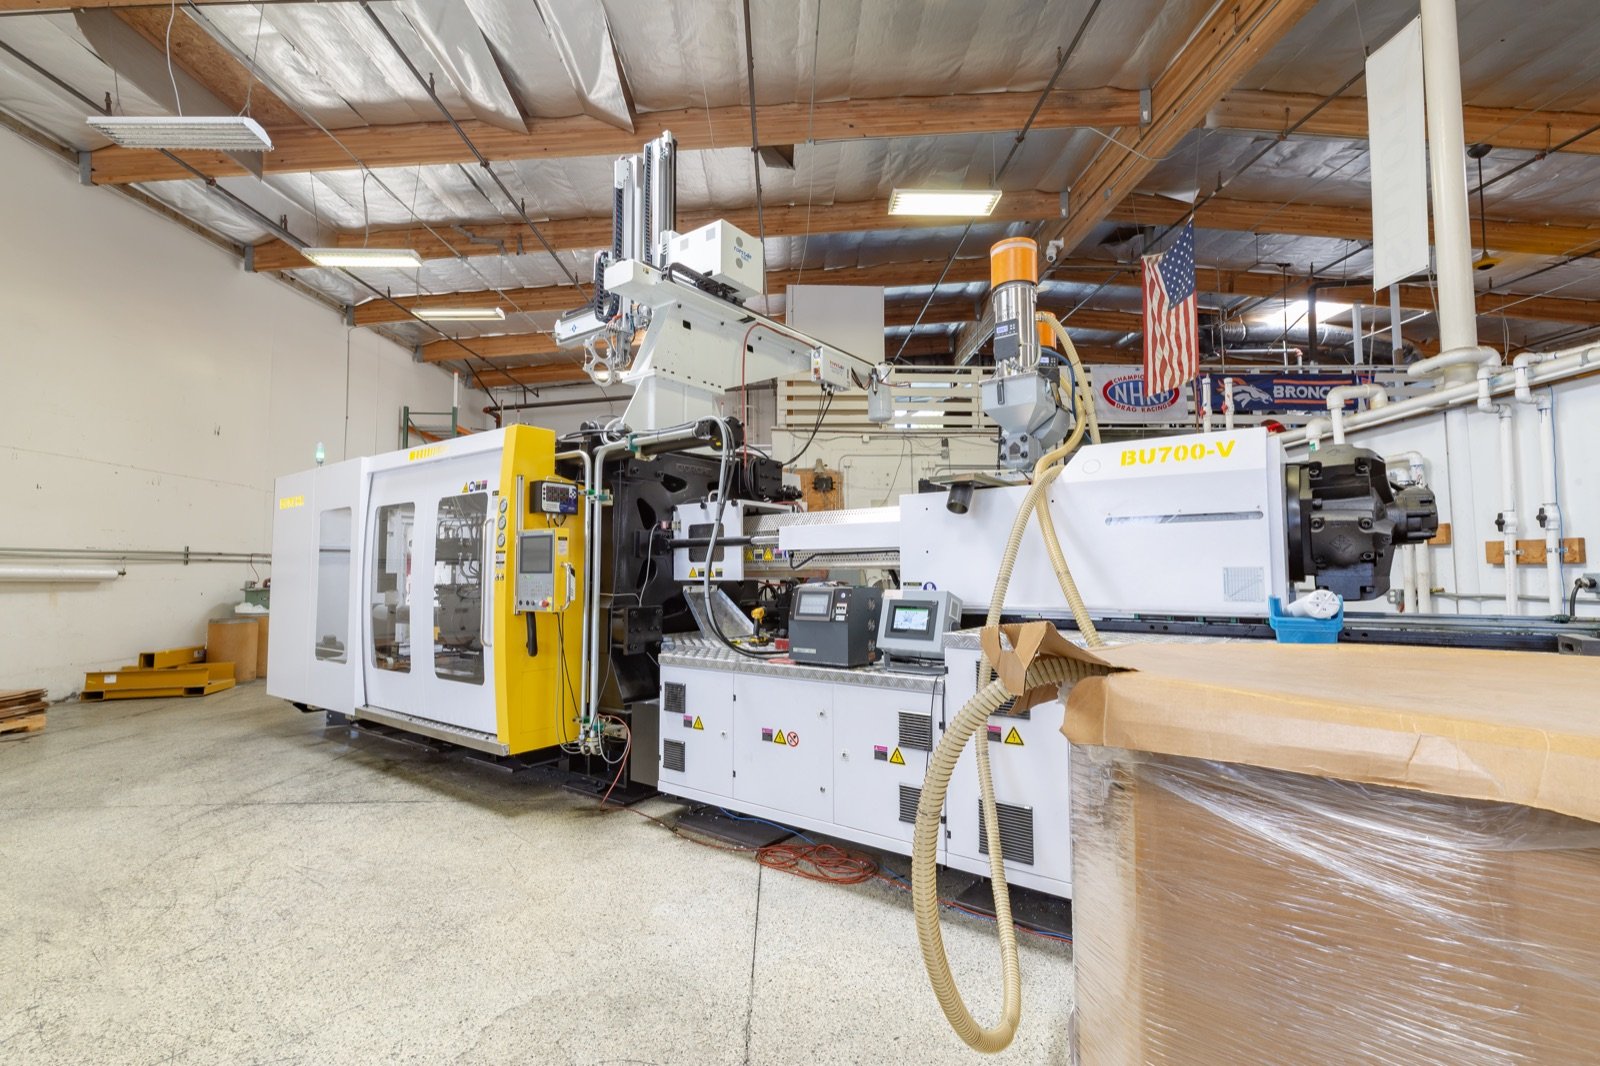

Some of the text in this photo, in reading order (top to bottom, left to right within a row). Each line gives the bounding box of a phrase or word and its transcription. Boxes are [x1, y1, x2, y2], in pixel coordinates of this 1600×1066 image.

[1113, 374, 1145, 383] CHAMPIO
[1273, 384, 1331, 400] BRONC
[1116, 403, 1169, 413] DRAG RACING
[1120, 439, 1236, 467] BU700-V
